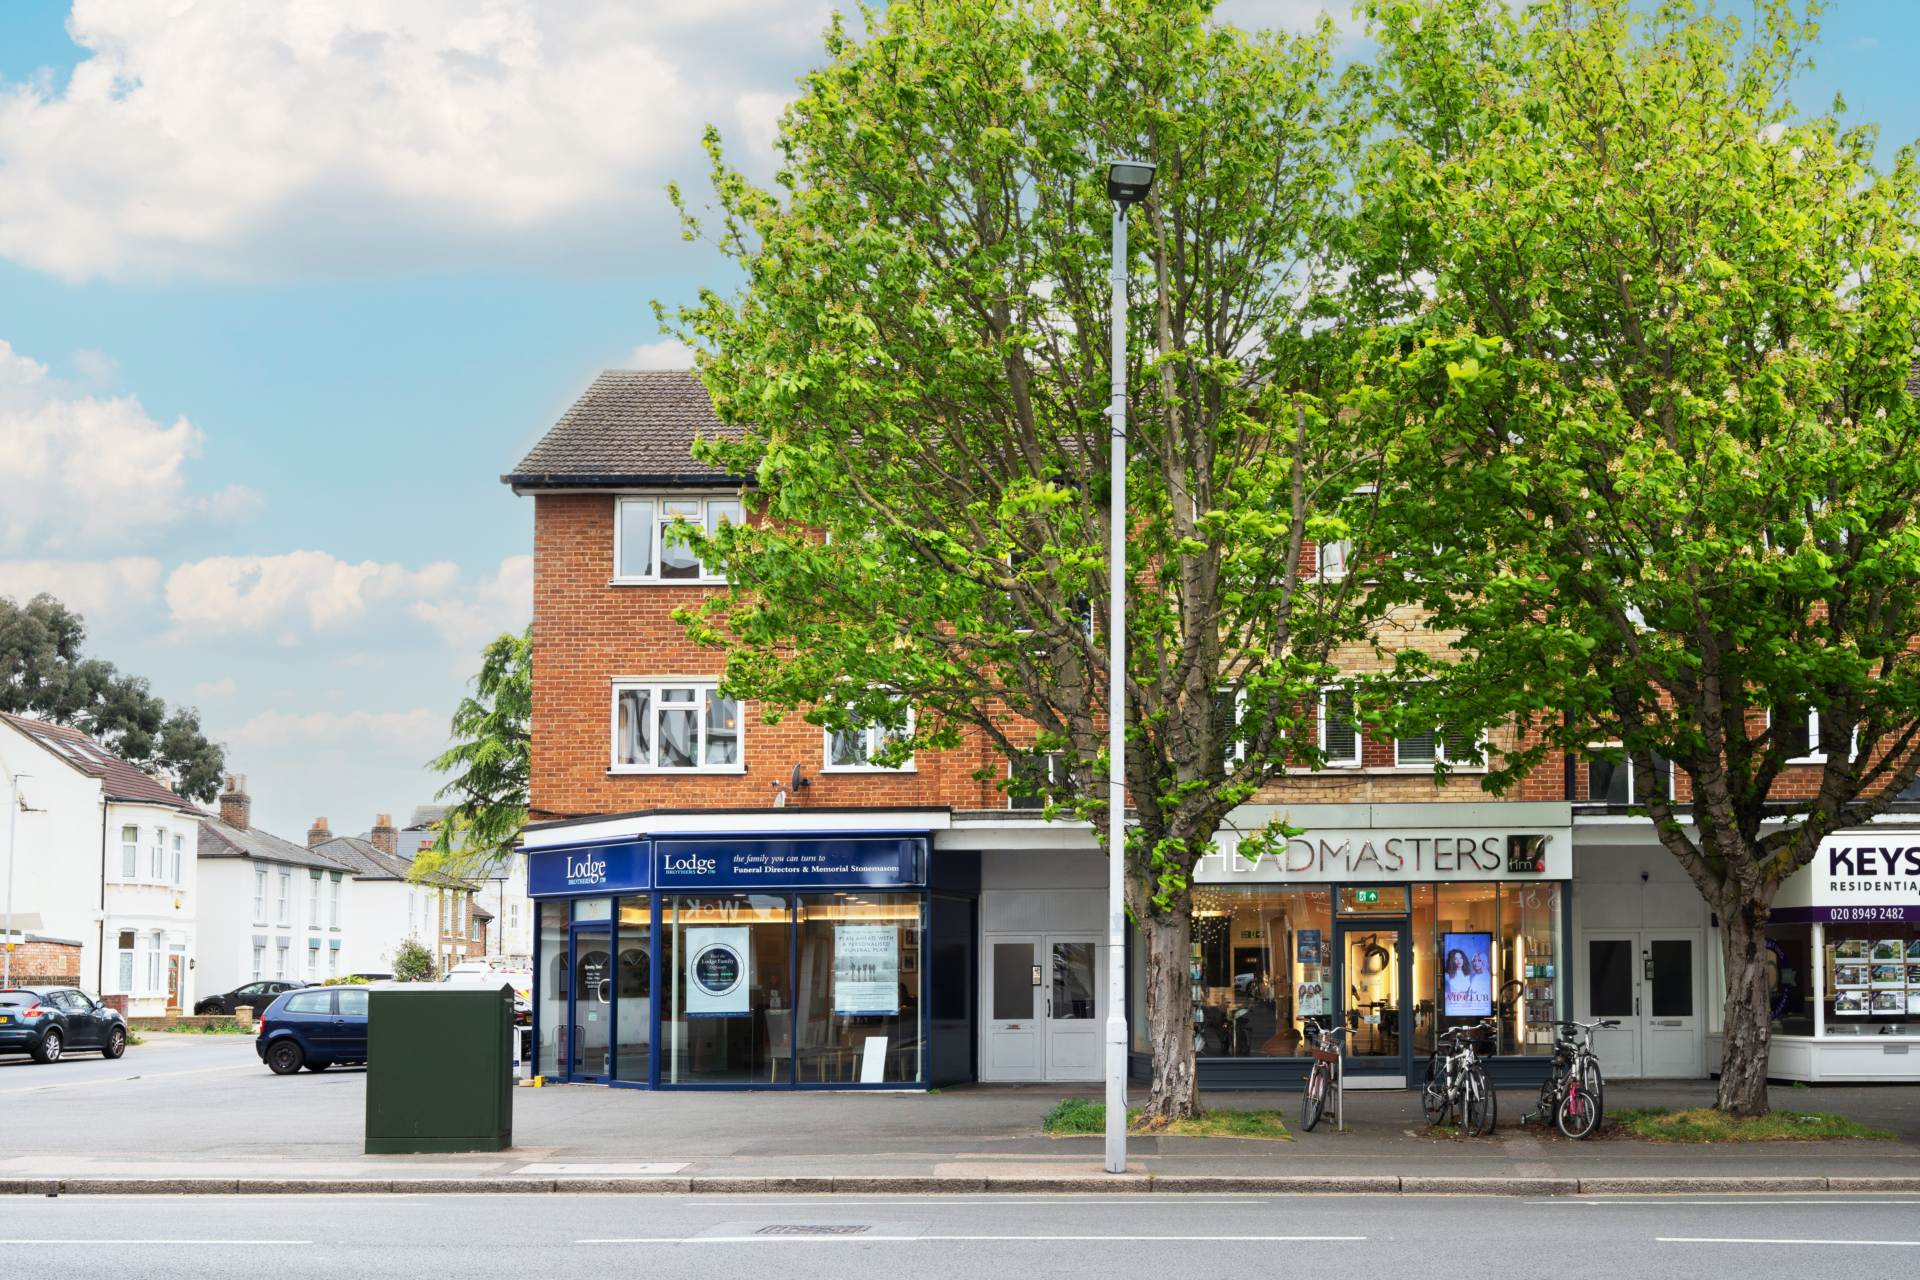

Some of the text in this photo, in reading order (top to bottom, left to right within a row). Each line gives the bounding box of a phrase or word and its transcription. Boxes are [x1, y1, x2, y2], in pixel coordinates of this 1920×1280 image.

[733, 854, 744, 862] the
[745, 854, 769, 865] family
[1200, 838, 1501, 872] HEADMASTERS
[566, 853, 606, 884] Lodge
[664, 853, 716, 875] Lodge
[811, 865, 849, 873] Memorial
[1830, 907, 1905, 920] 020 8949 2482
